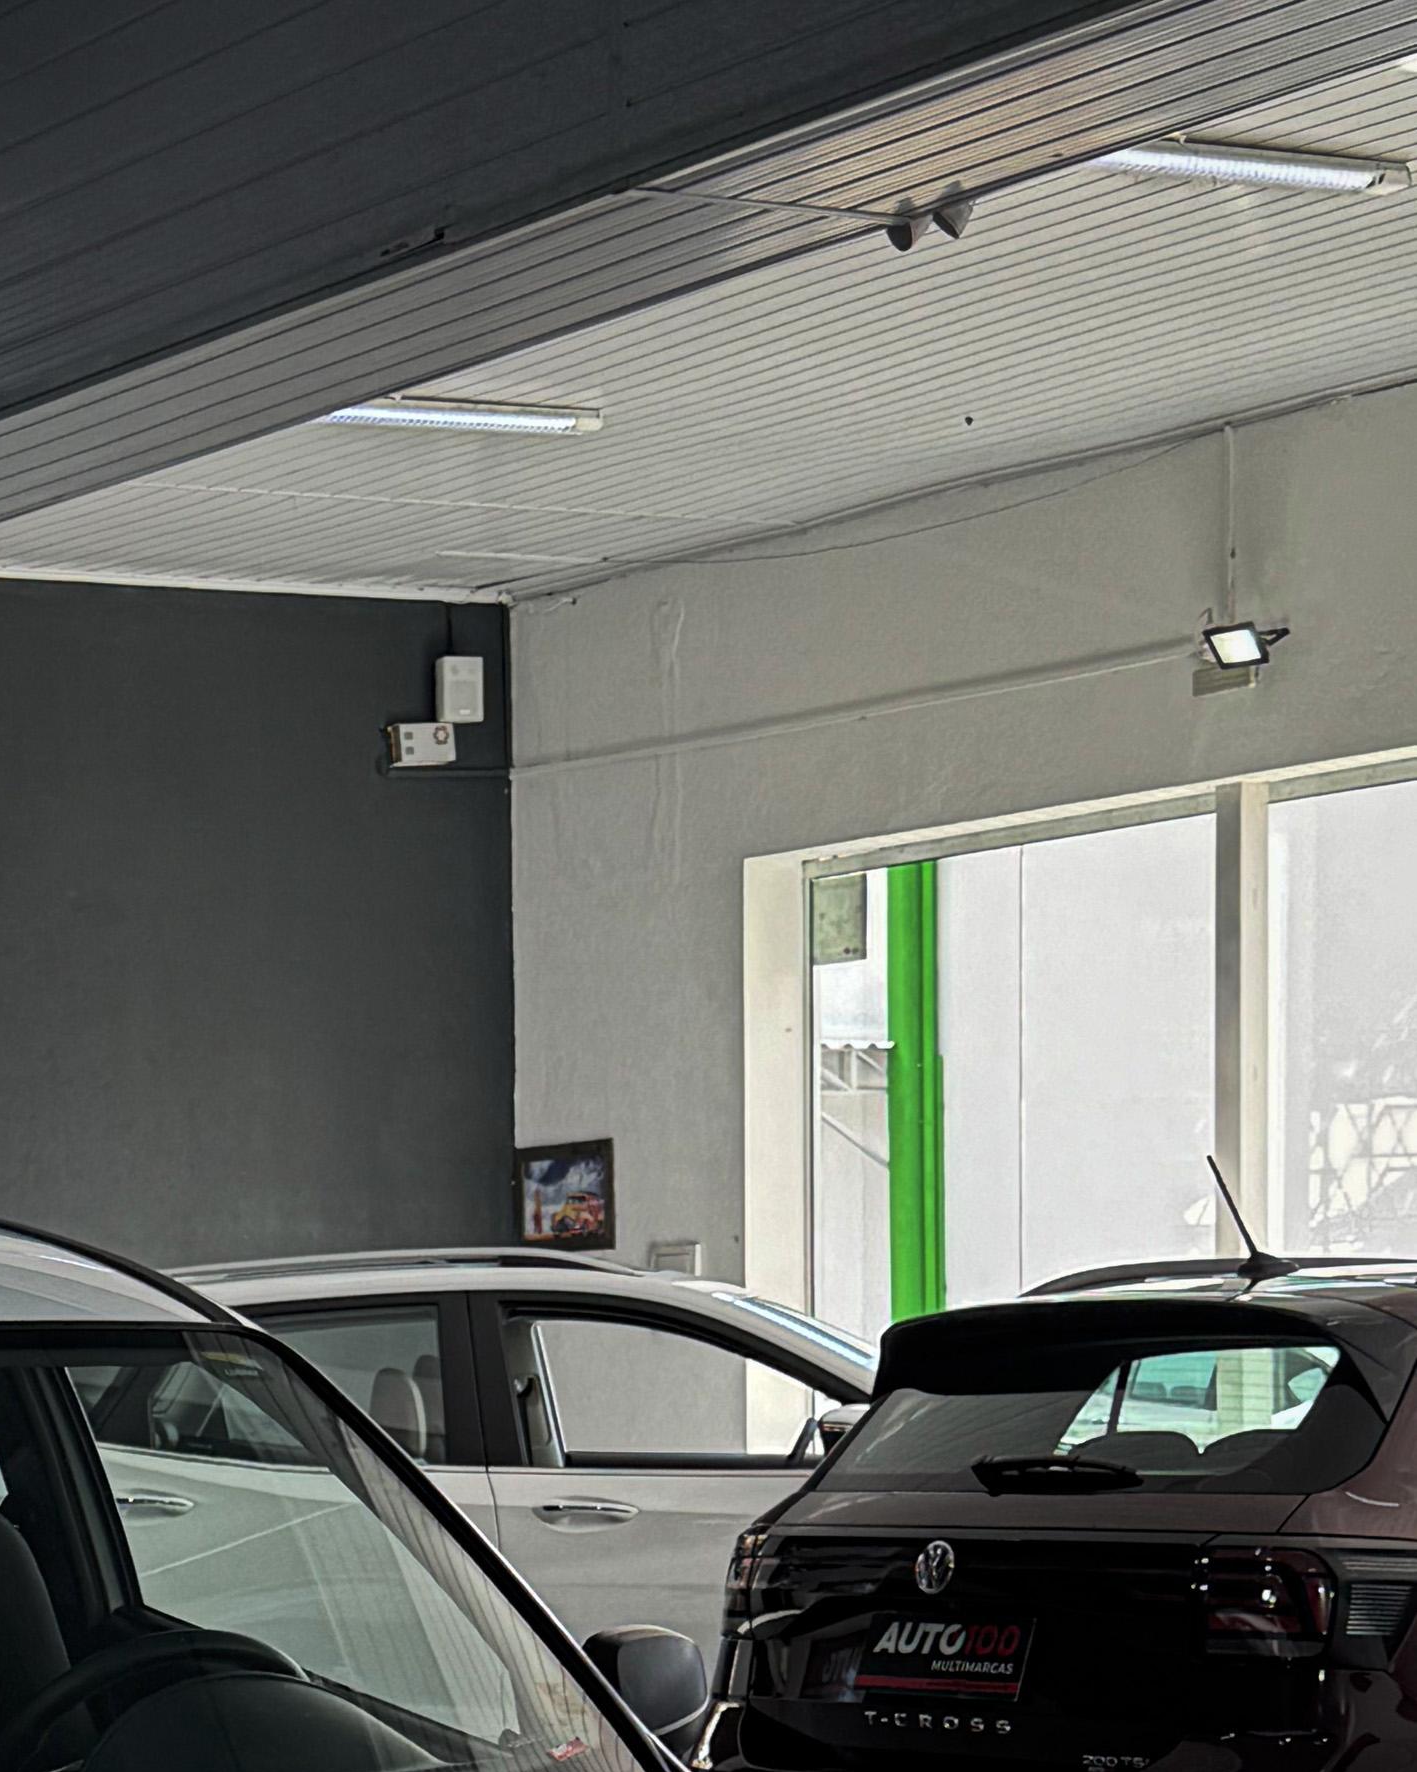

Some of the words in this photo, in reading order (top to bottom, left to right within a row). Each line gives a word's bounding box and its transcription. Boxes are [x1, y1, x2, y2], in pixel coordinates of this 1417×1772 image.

[872, 1621, 1021, 1656] AUTO100
[931, 1660, 1014, 1675] MULTIMARCAS
[864, 1710, 1012, 1734] T-CROSS
